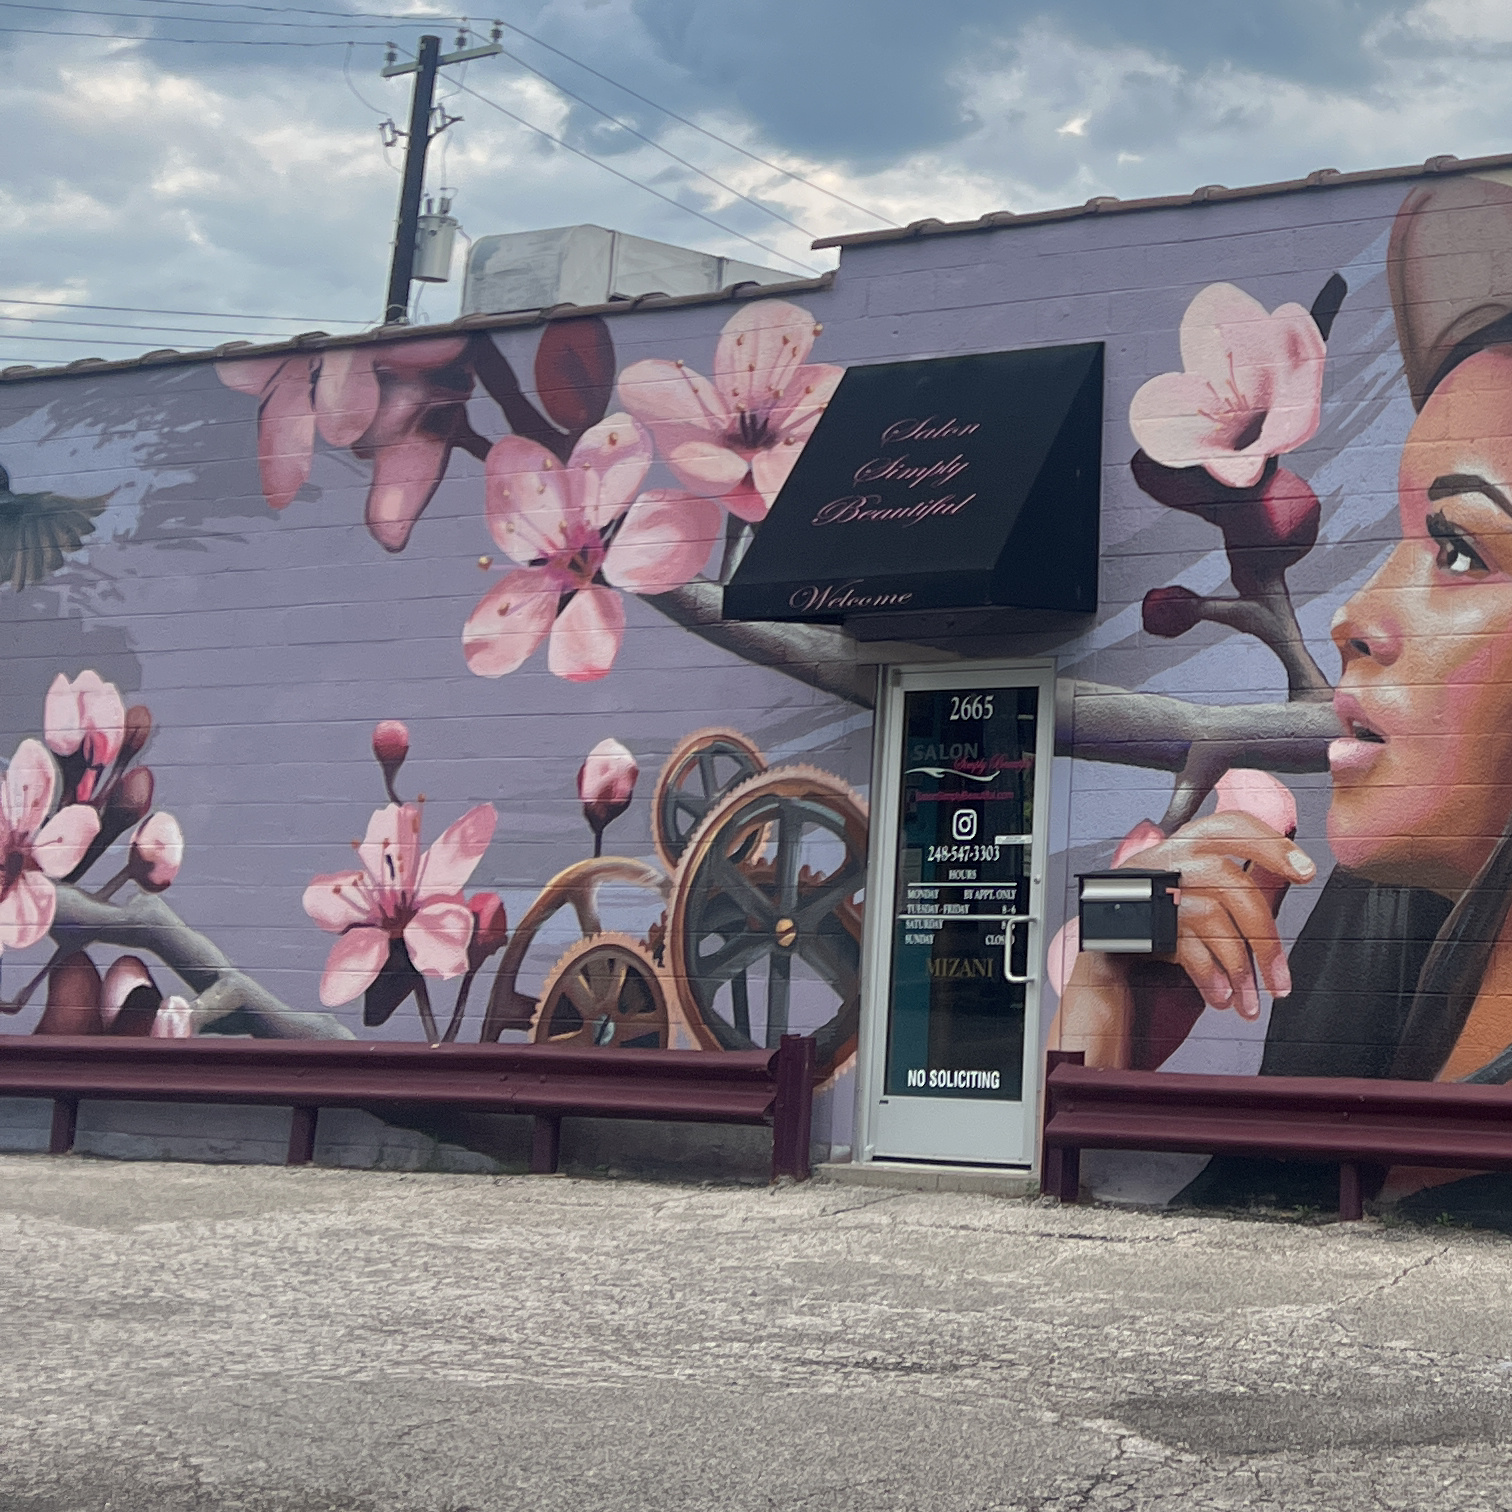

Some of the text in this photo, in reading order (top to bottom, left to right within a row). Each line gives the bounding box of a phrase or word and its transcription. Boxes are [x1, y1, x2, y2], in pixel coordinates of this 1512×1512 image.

[881, 415, 981, 447] Salon
[853, 454, 970, 489] Simply
[811, 493, 977, 527] Beautiful
[788, 579, 913, 612] Welcome
[950, 694, 995, 721] 2665
[911, 742, 979, 761] SALON
[927, 845, 1000, 863] 248-547-3303
[948, 869, 977, 880] HOURS
[907, 889, 940, 900] MONDAY
[996, 889, 1017, 900] ONLY
[905, 919, 944, 930] SATURDAY
[904, 934, 936, 945] SUNDAY
[926, 958, 993, 978] MIZANI
[907, 1068, 1001, 1090] NO SOLICITING
